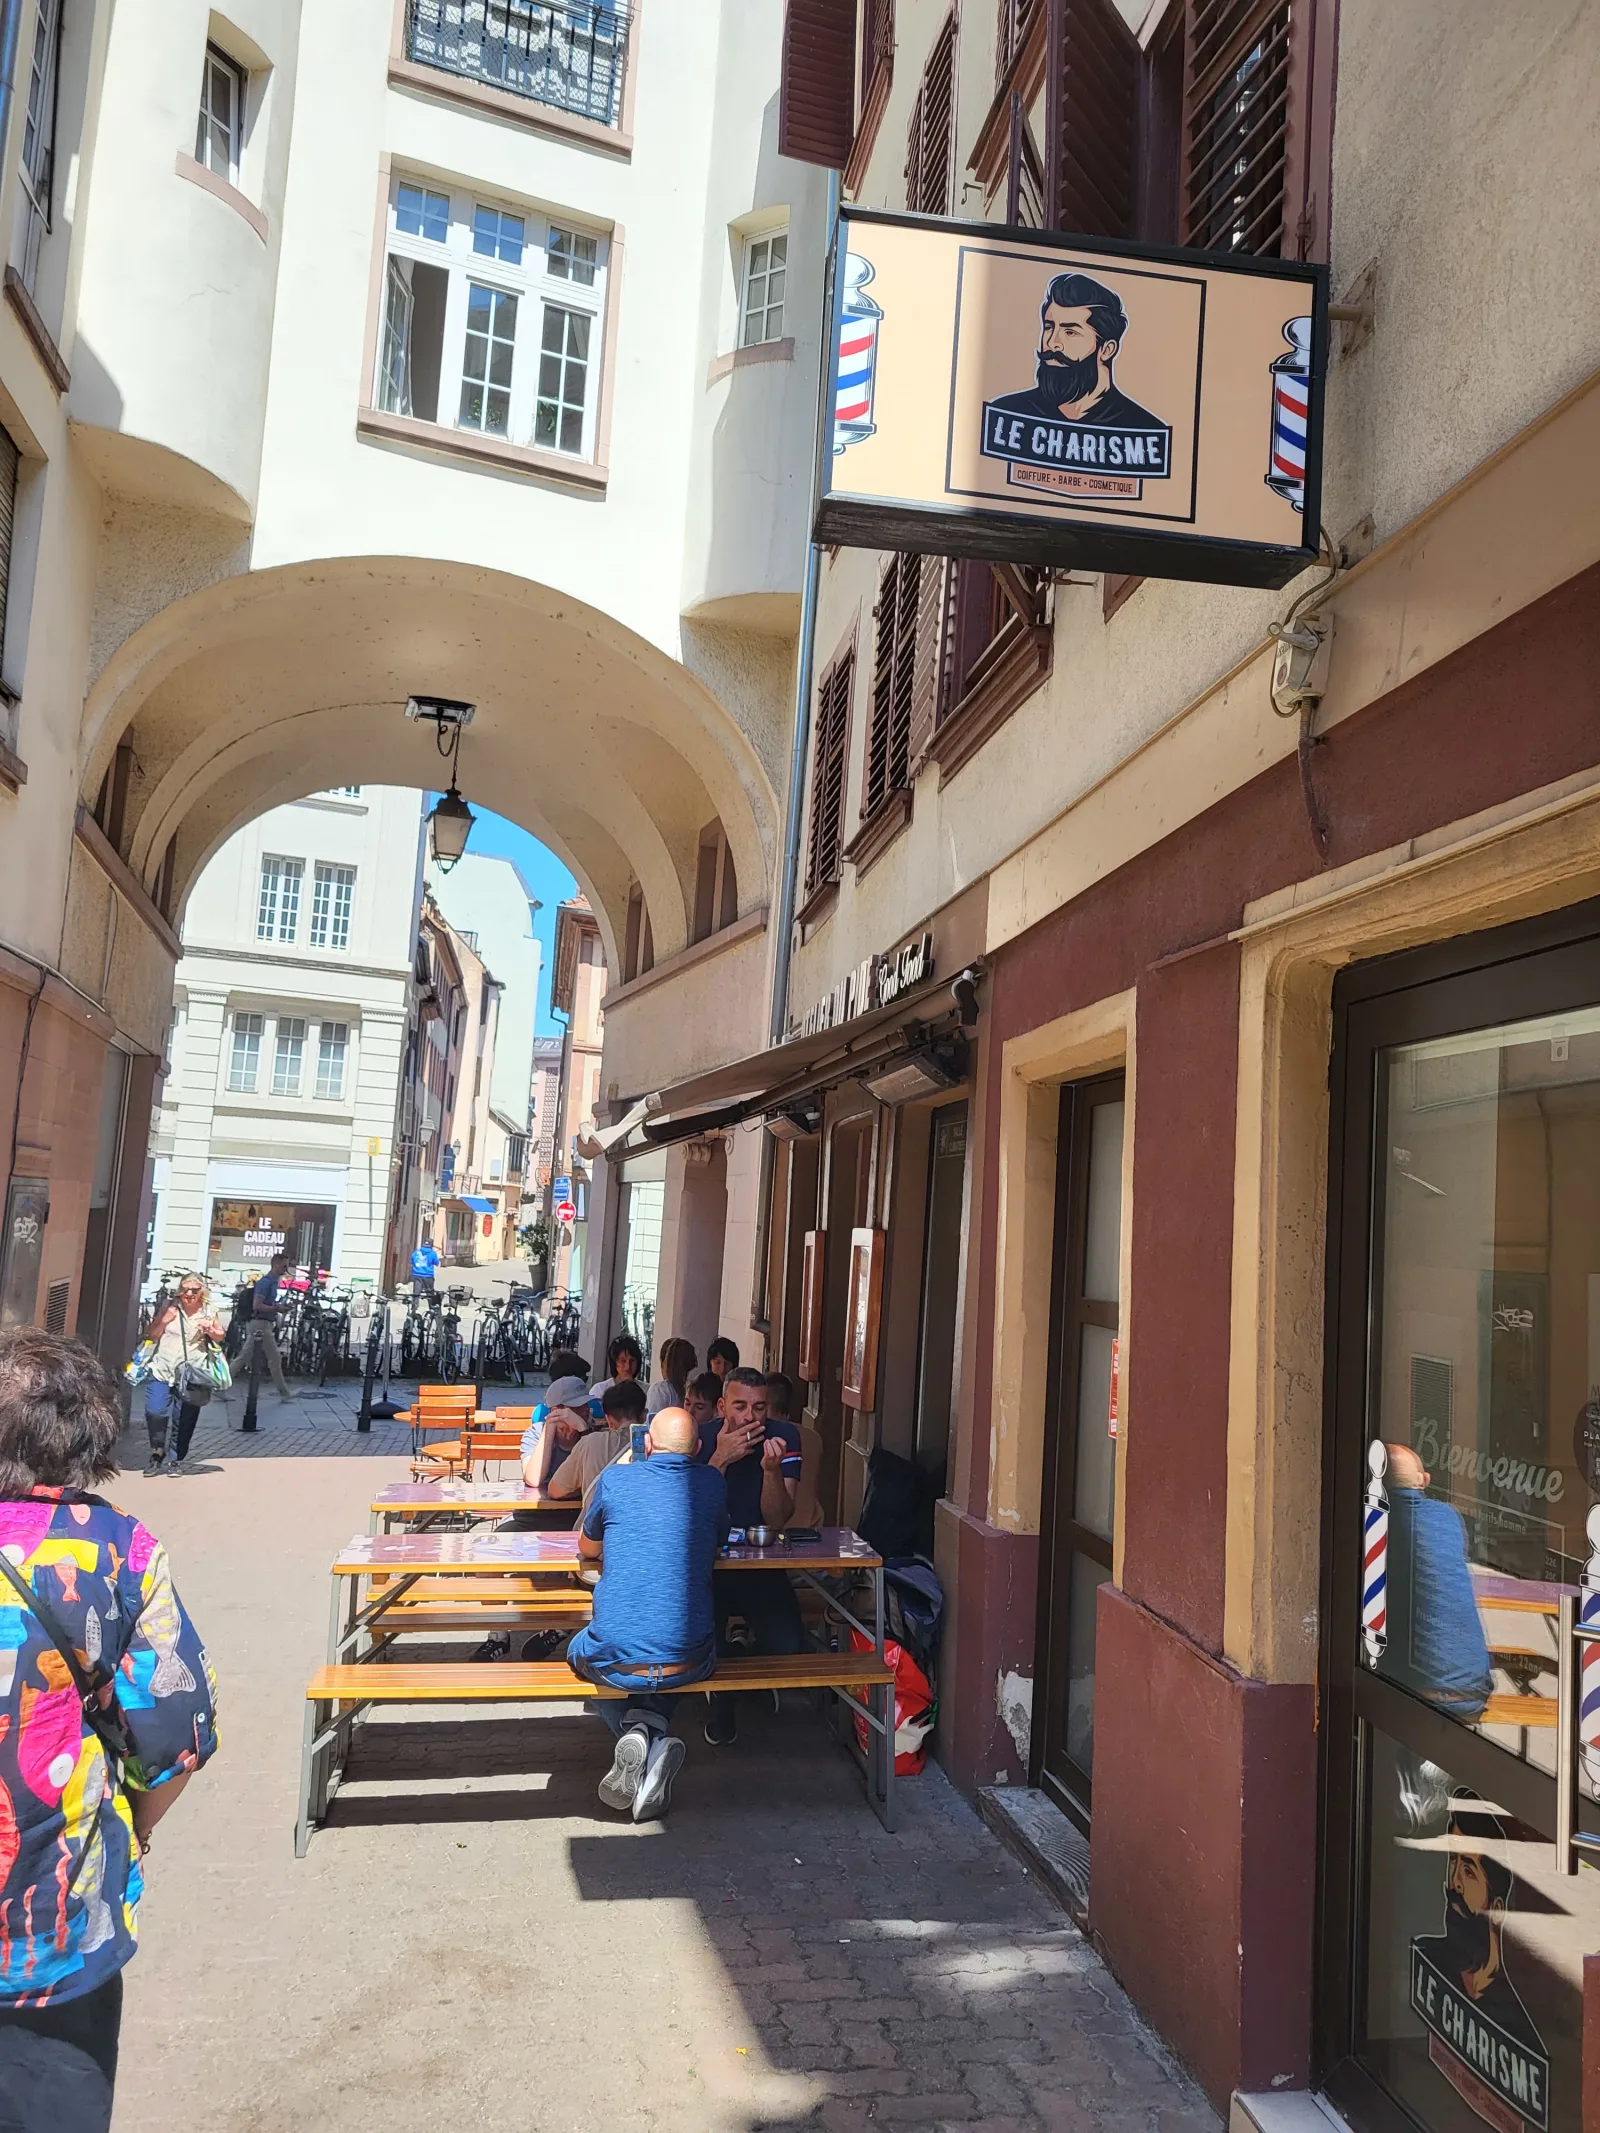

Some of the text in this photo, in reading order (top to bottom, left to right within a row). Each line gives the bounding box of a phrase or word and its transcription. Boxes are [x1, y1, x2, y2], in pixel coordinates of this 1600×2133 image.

[993, 416, 1163, 465] LE CHARISME
[1017, 469, 1133, 493] COIFFURE BARBE COSMETIQUE
[879, 933, 925, 1007] Good Food
[258, 1217, 272, 1229] LE
[244, 1230, 285, 1244] CADEAU
[242, 1244, 285, 1257] PARFAIT
[1413, 1416, 1565, 1503] Bienvenue
[1498, 1511, 1527, 1535] homme
[1416, 1963, 1438, 2018] LE
[1441, 1993, 1544, 2112] CHARISME
